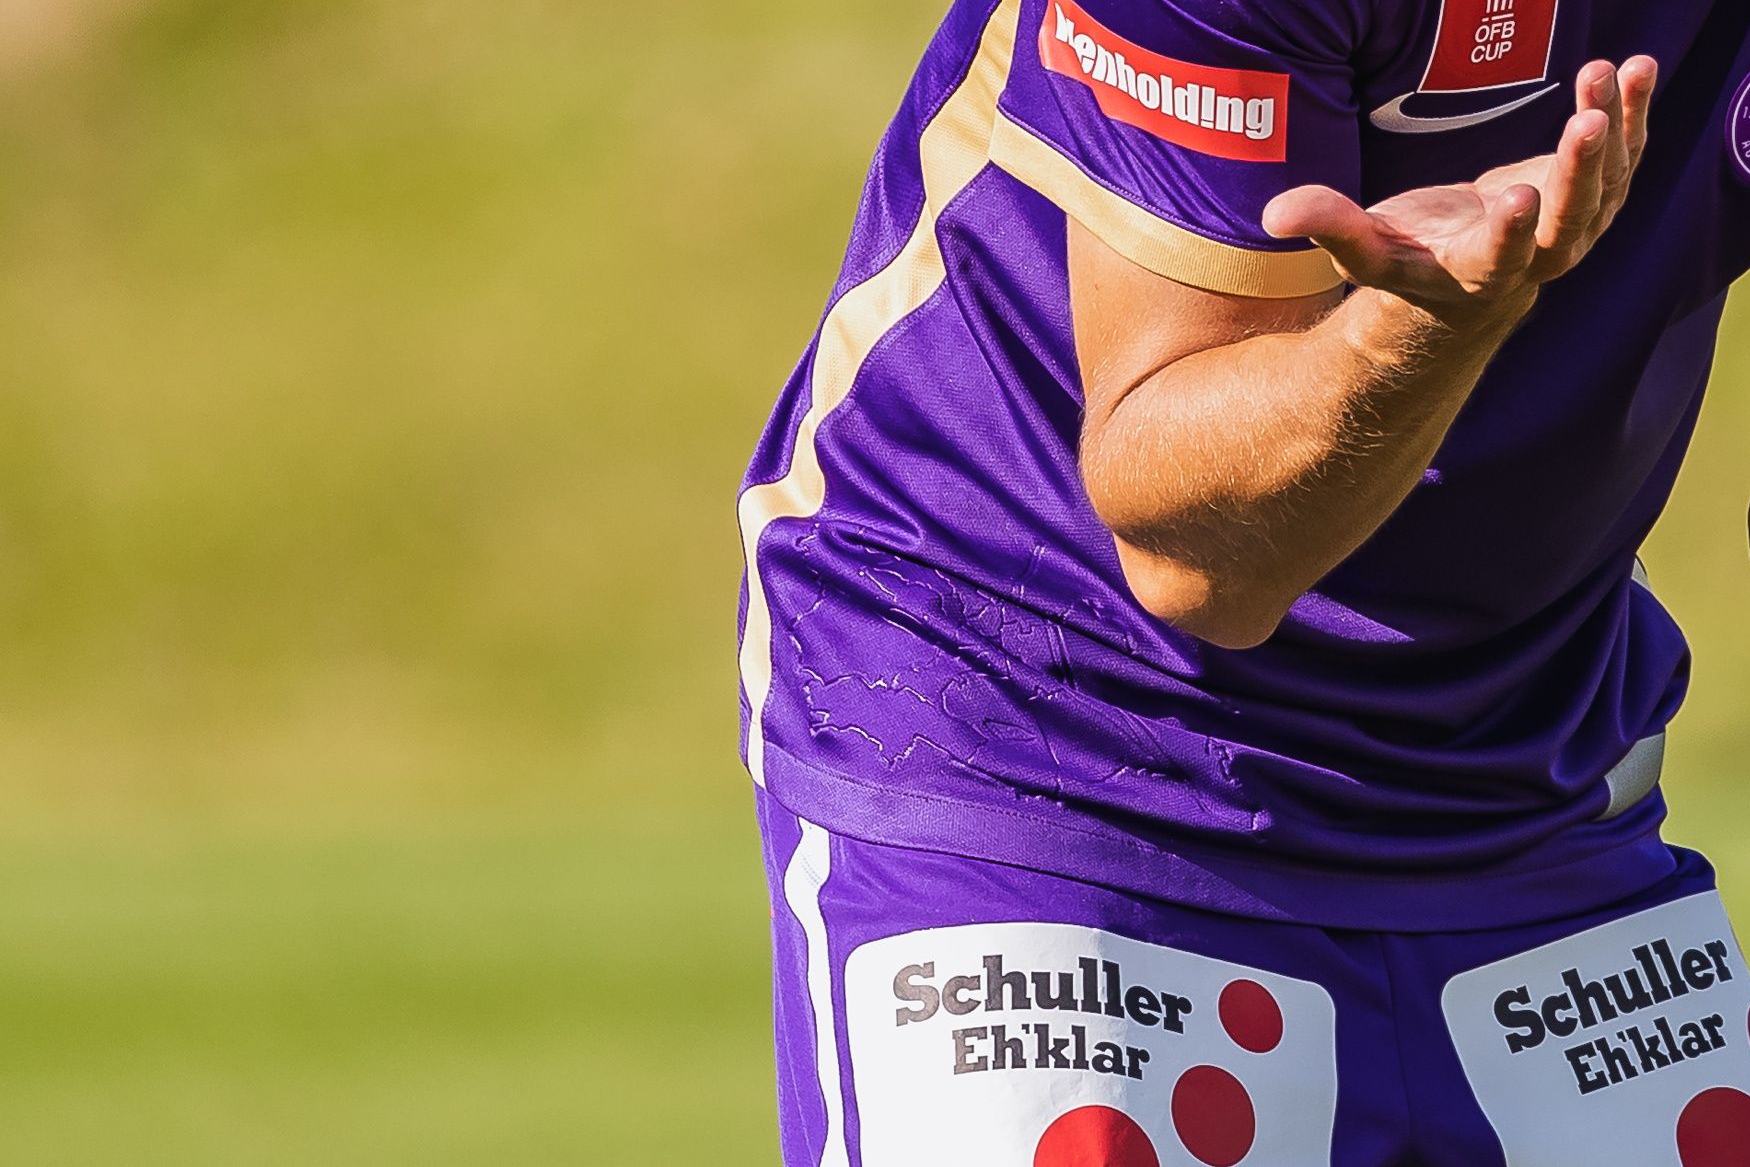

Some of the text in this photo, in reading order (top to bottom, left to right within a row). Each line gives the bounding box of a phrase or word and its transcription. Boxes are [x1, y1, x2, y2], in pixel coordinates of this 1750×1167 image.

[1470, 40, 1513, 63] CUP
[893, 954, 1193, 1034] Schuller
[1493, 937, 1734, 1055] Schuller
